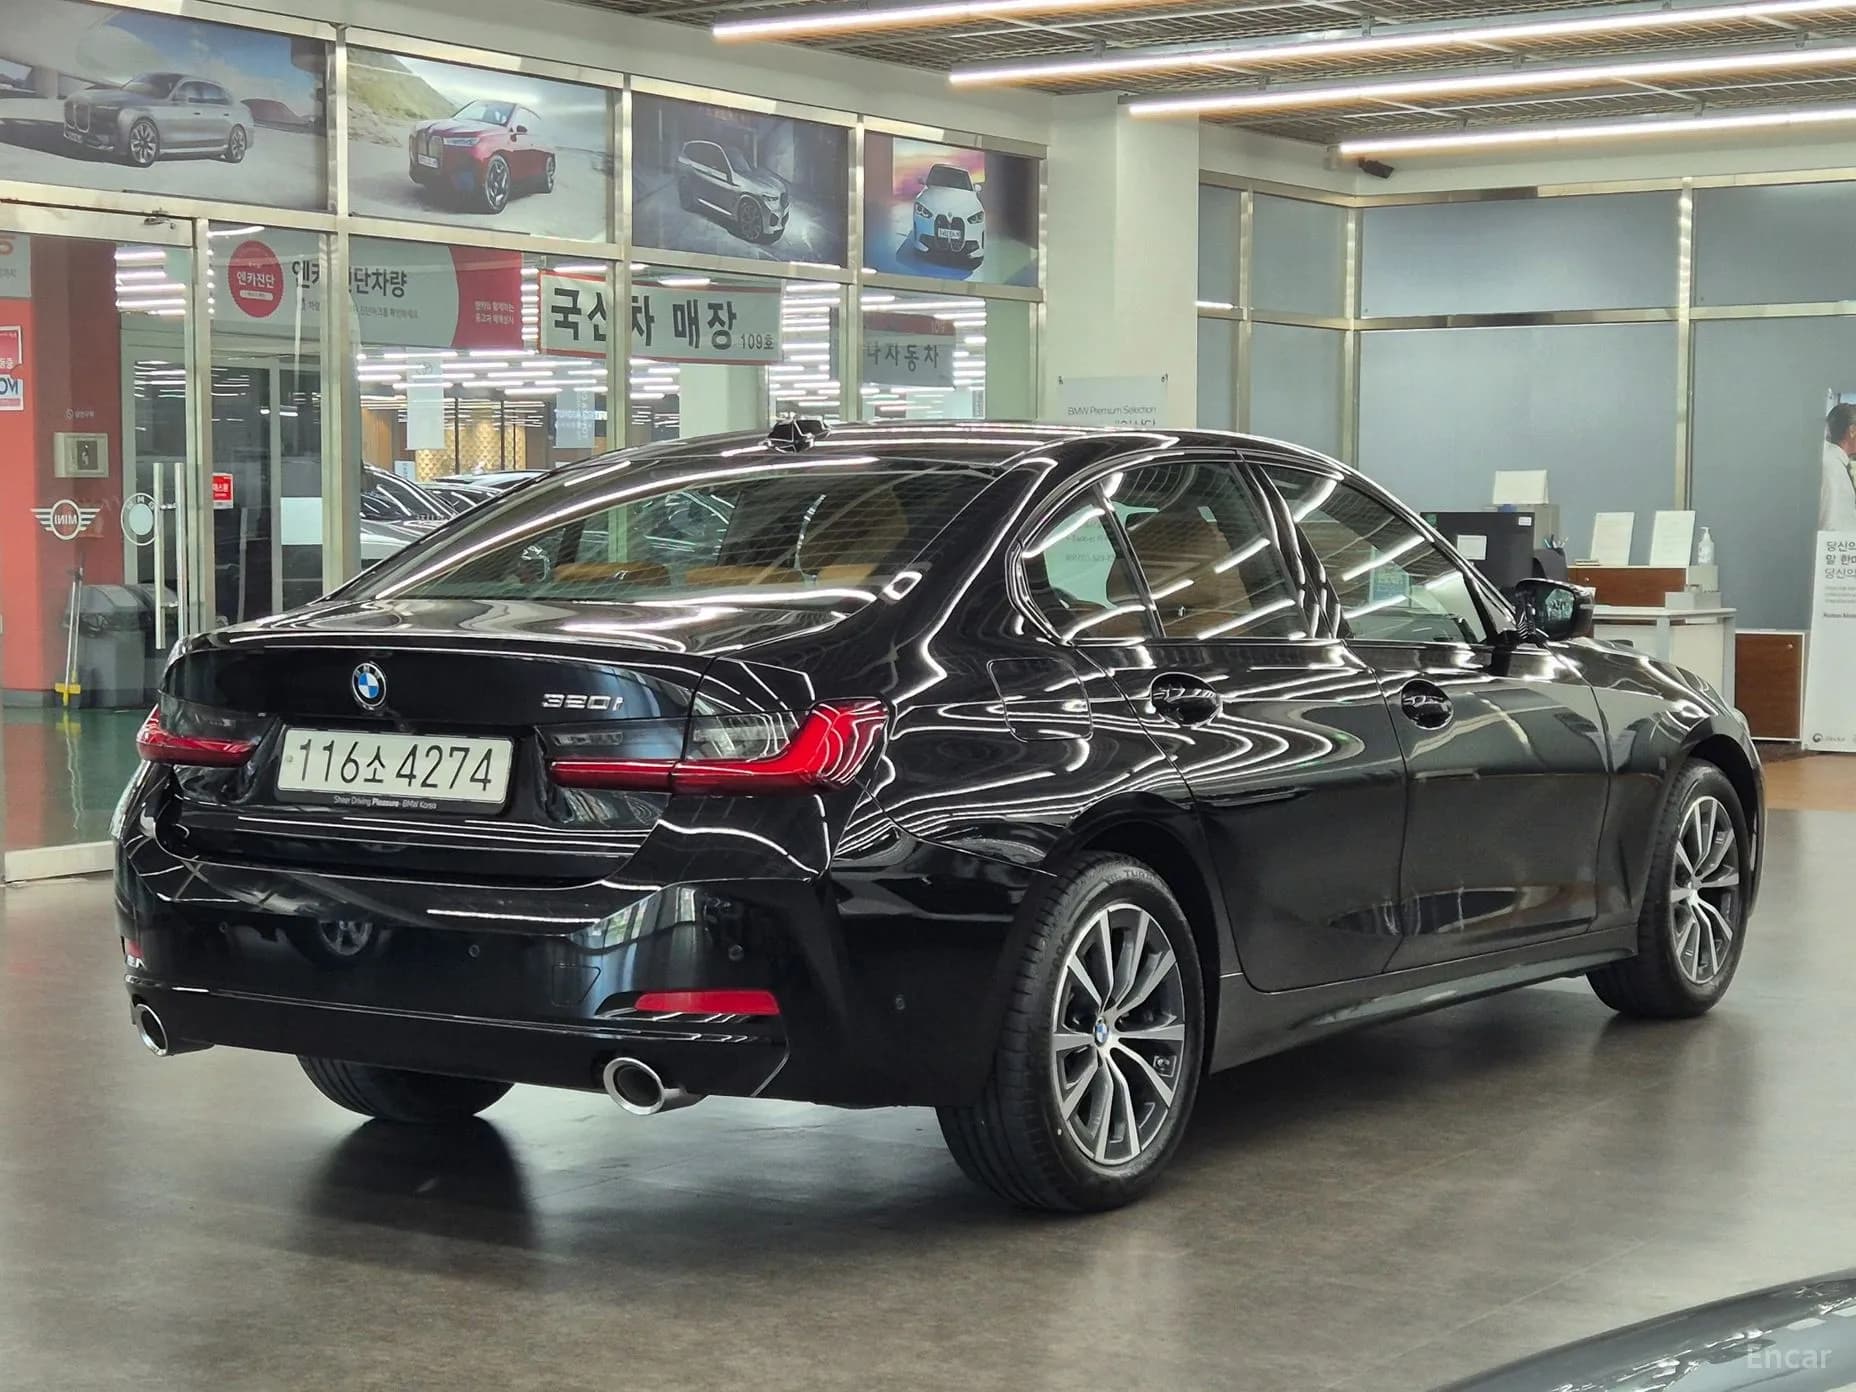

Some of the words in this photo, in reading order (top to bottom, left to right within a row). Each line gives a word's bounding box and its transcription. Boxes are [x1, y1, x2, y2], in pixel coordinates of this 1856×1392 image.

[672, 299, 737, 350] 매장
[740, 333, 775, 350] 109호
[1067, 407, 1089, 416] BMW
[1090, 406, 1121, 415] Premium
[1122, 404, 1157, 415] Selection
[334, 795, 351, 805] Sheer
[351, 796, 371, 807] Driving
[372, 797, 400, 808] Pleasure
[402, 799, 418, 808] BMW
[419, 800, 437, 810] Korea
